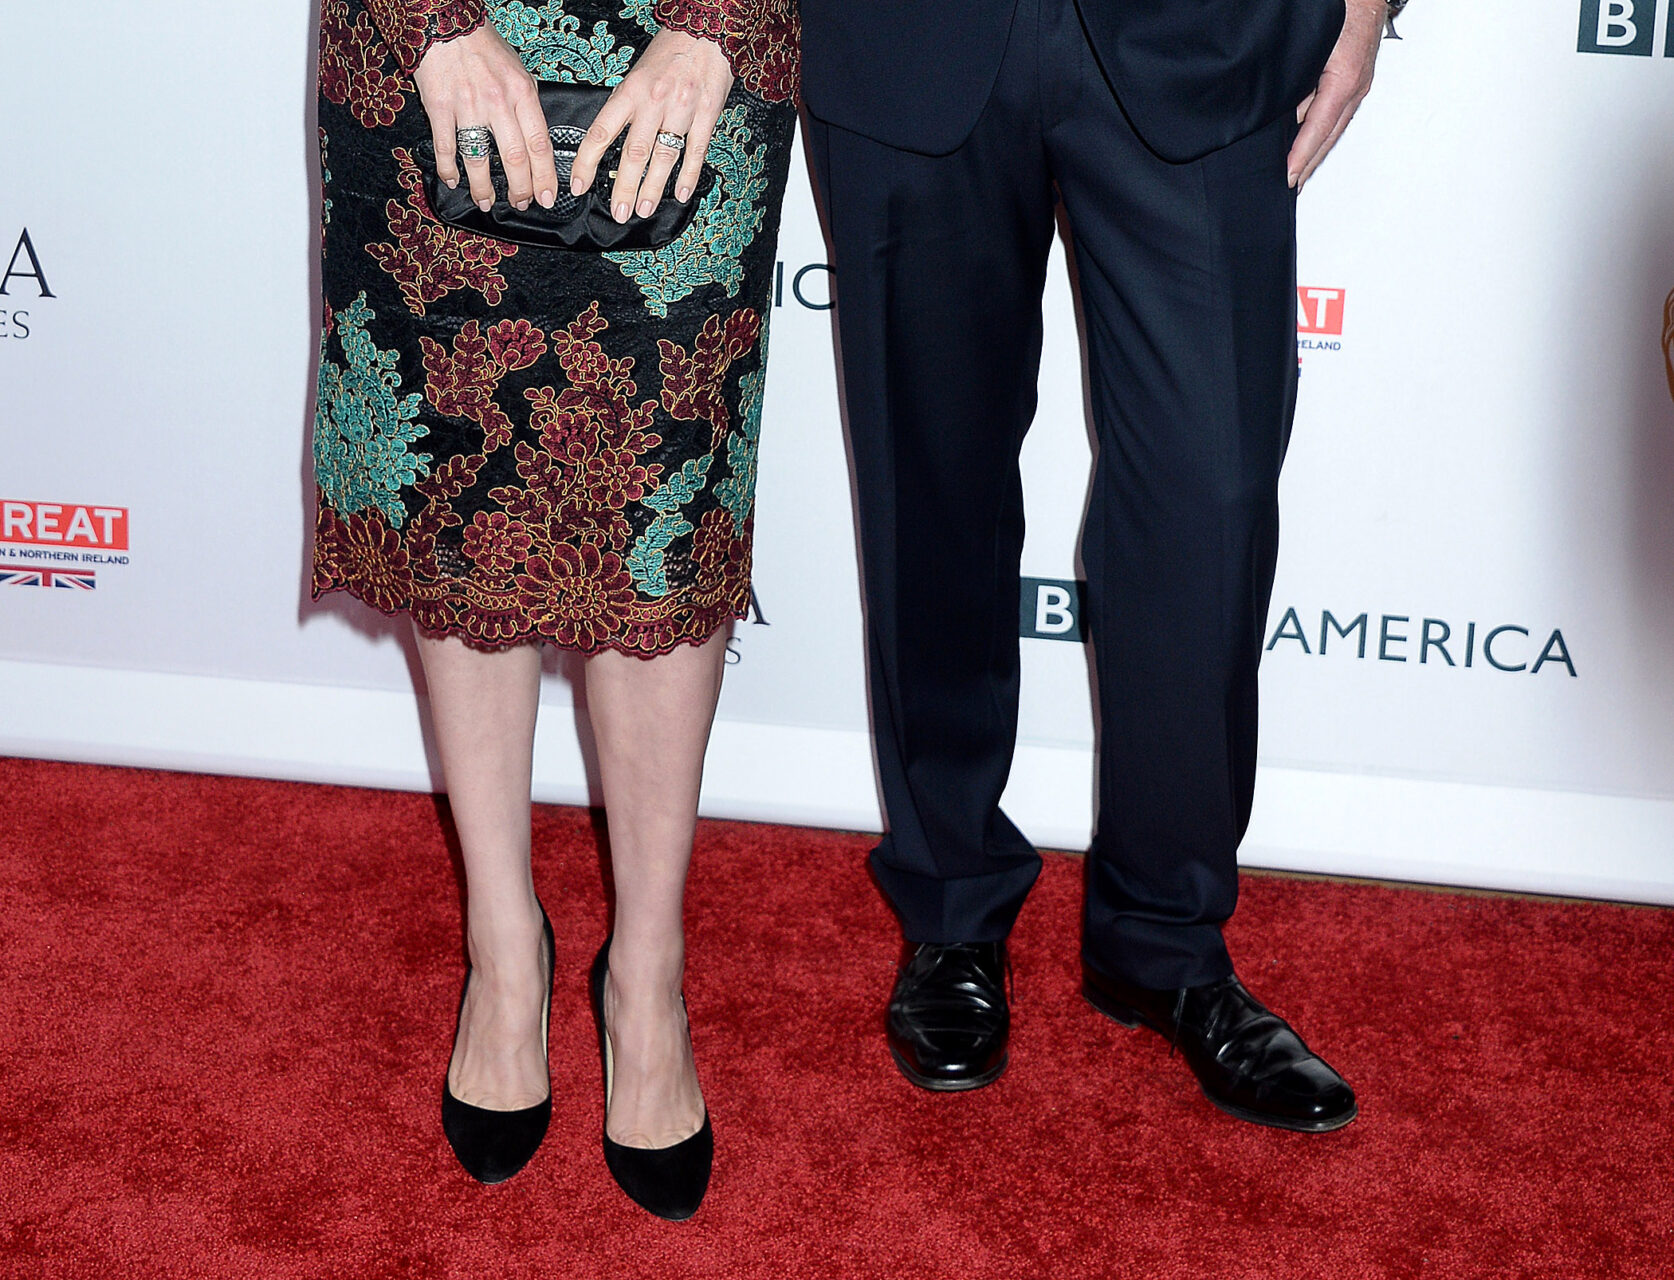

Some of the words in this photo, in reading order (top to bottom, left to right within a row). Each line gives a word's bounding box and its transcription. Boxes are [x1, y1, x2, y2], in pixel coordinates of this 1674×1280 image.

[3, 502, 122, 545] REAT
[20, 549, 79, 562] NORTHERN
[82, 553, 129, 565] IRELAND
[1266, 606, 1578, 677] AMERICA
